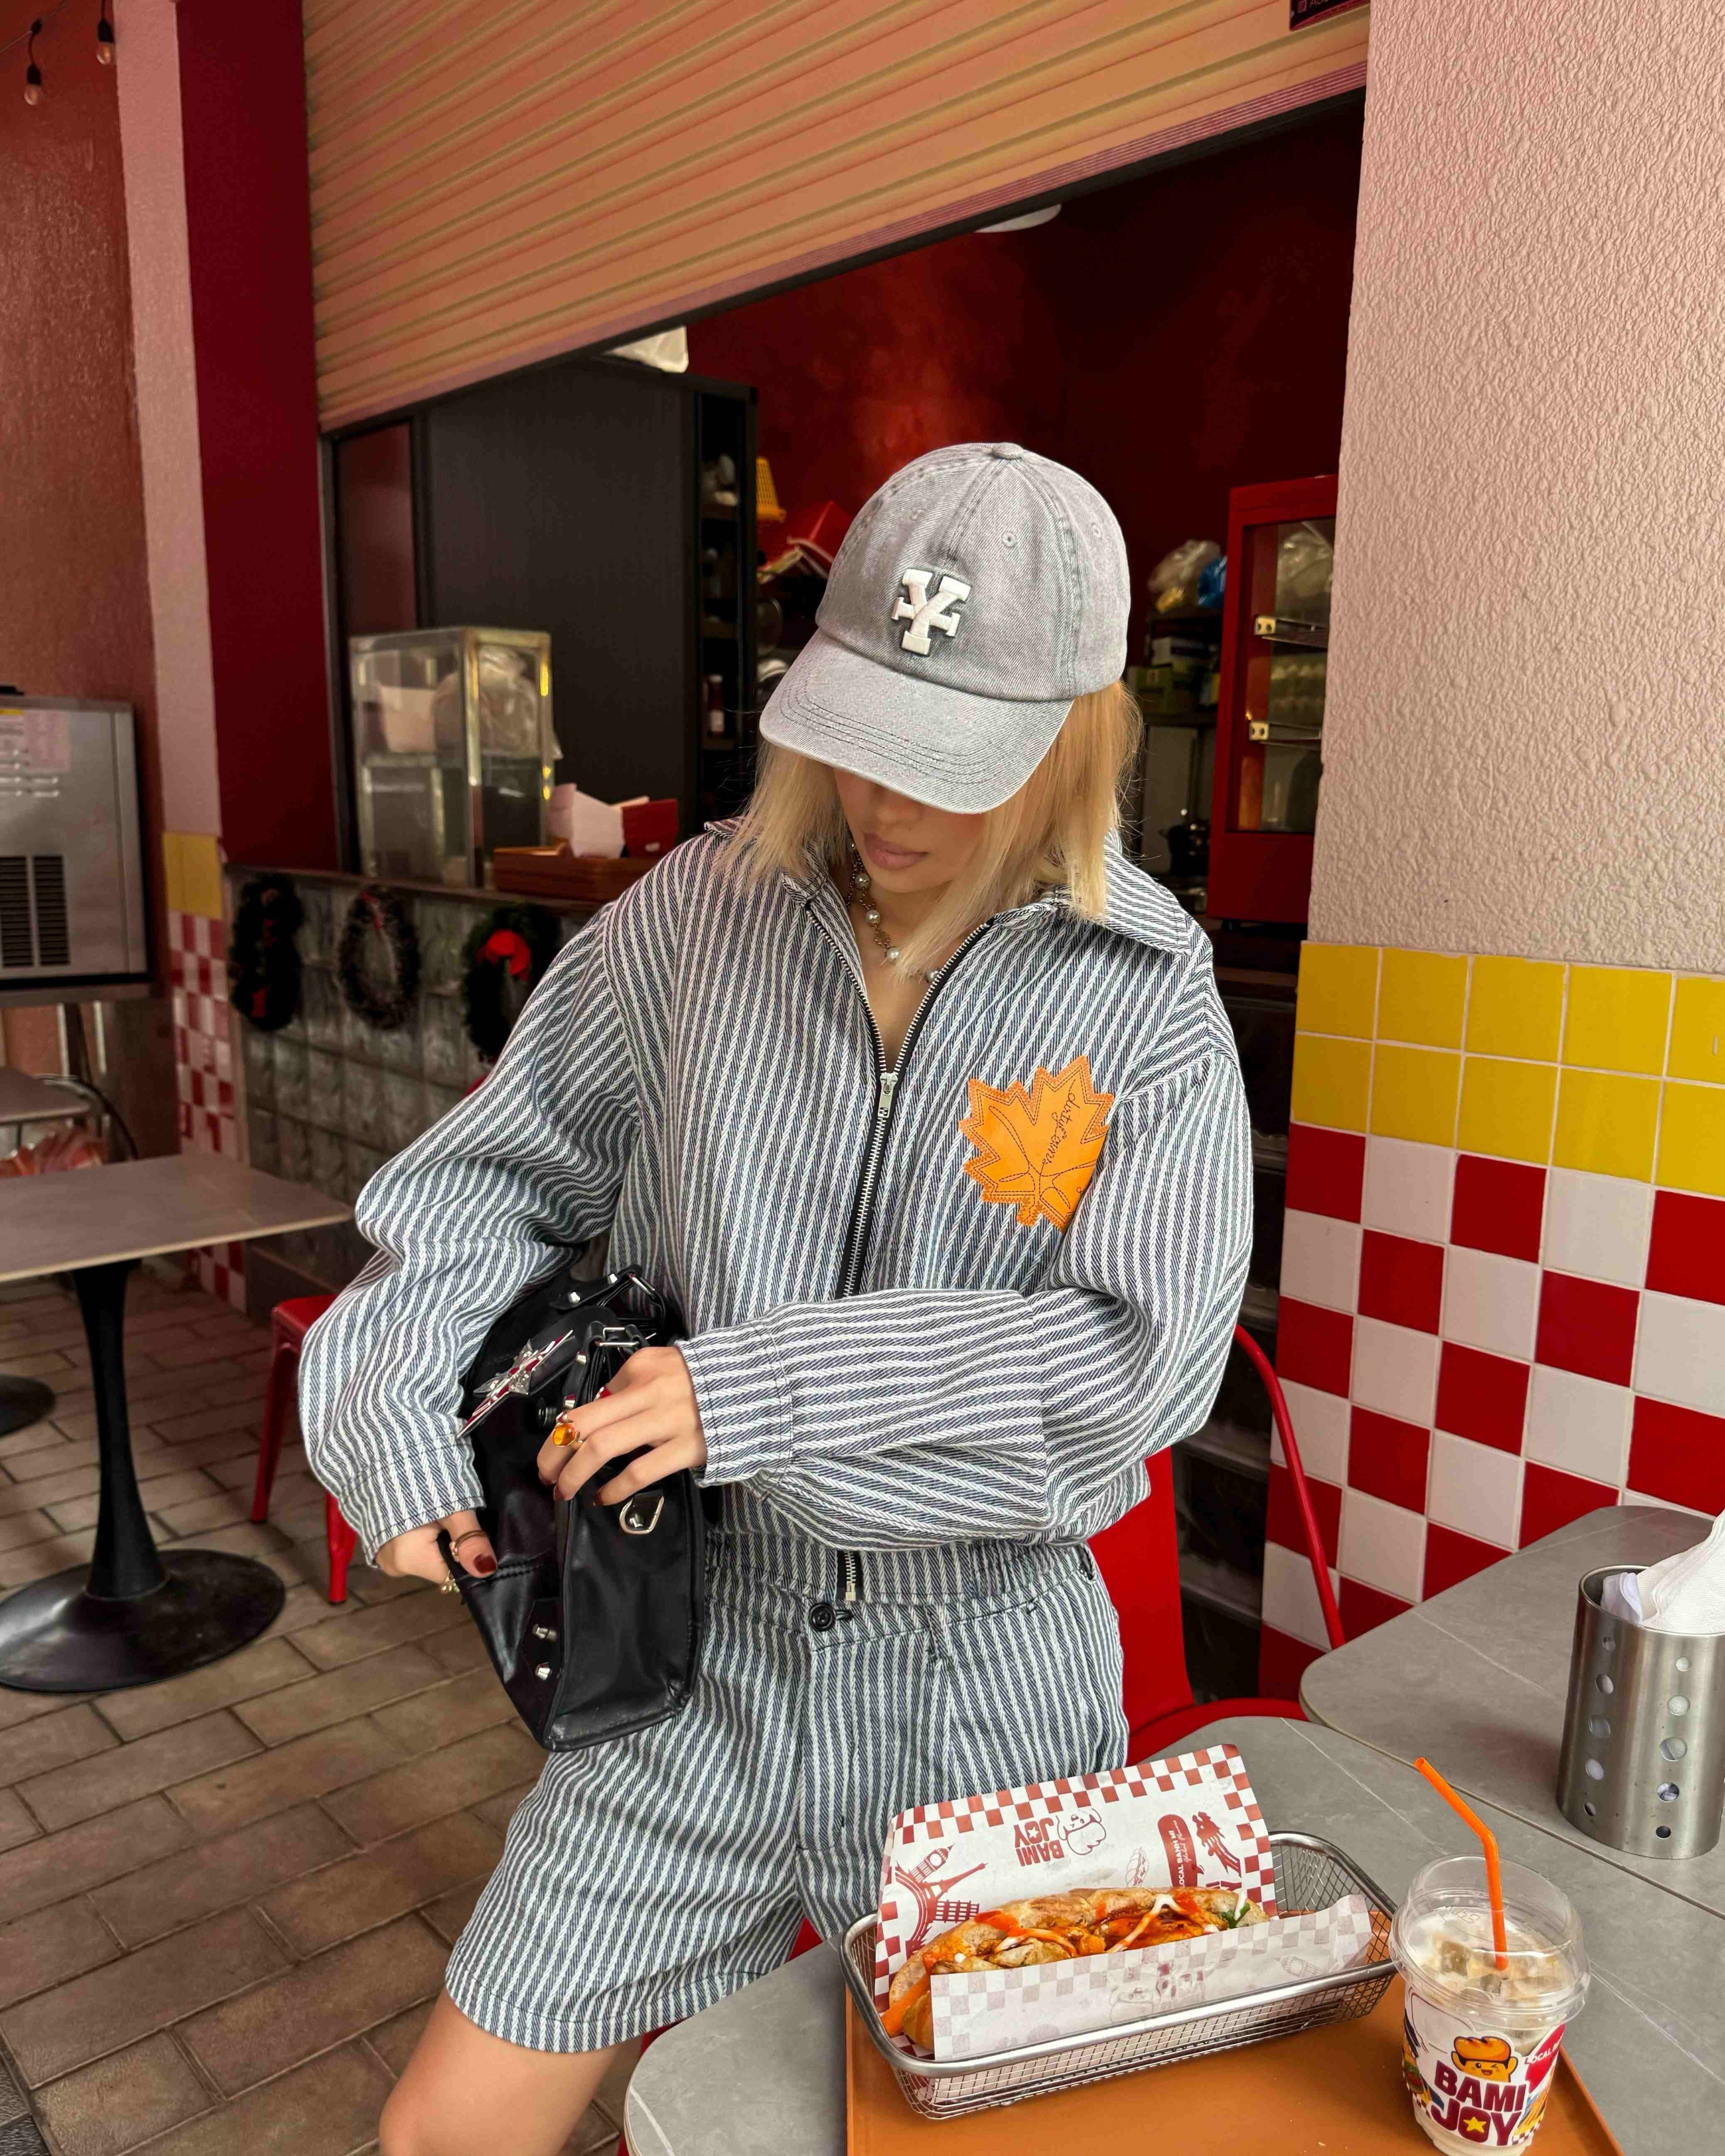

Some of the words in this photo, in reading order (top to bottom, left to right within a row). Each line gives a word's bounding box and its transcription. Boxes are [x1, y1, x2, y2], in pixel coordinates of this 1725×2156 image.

[1013, 1817, 1054, 1848] JOY
[1168, 1829, 1177, 1839] MI
[1015, 1839, 1065, 1867] BAMI
[1172, 1840, 1183, 1863] BANH
[1524, 2047, 1552, 2065] LOCAL
[1434, 2060, 1527, 2112] BAMI
[1431, 2097, 1522, 2146] JOY
